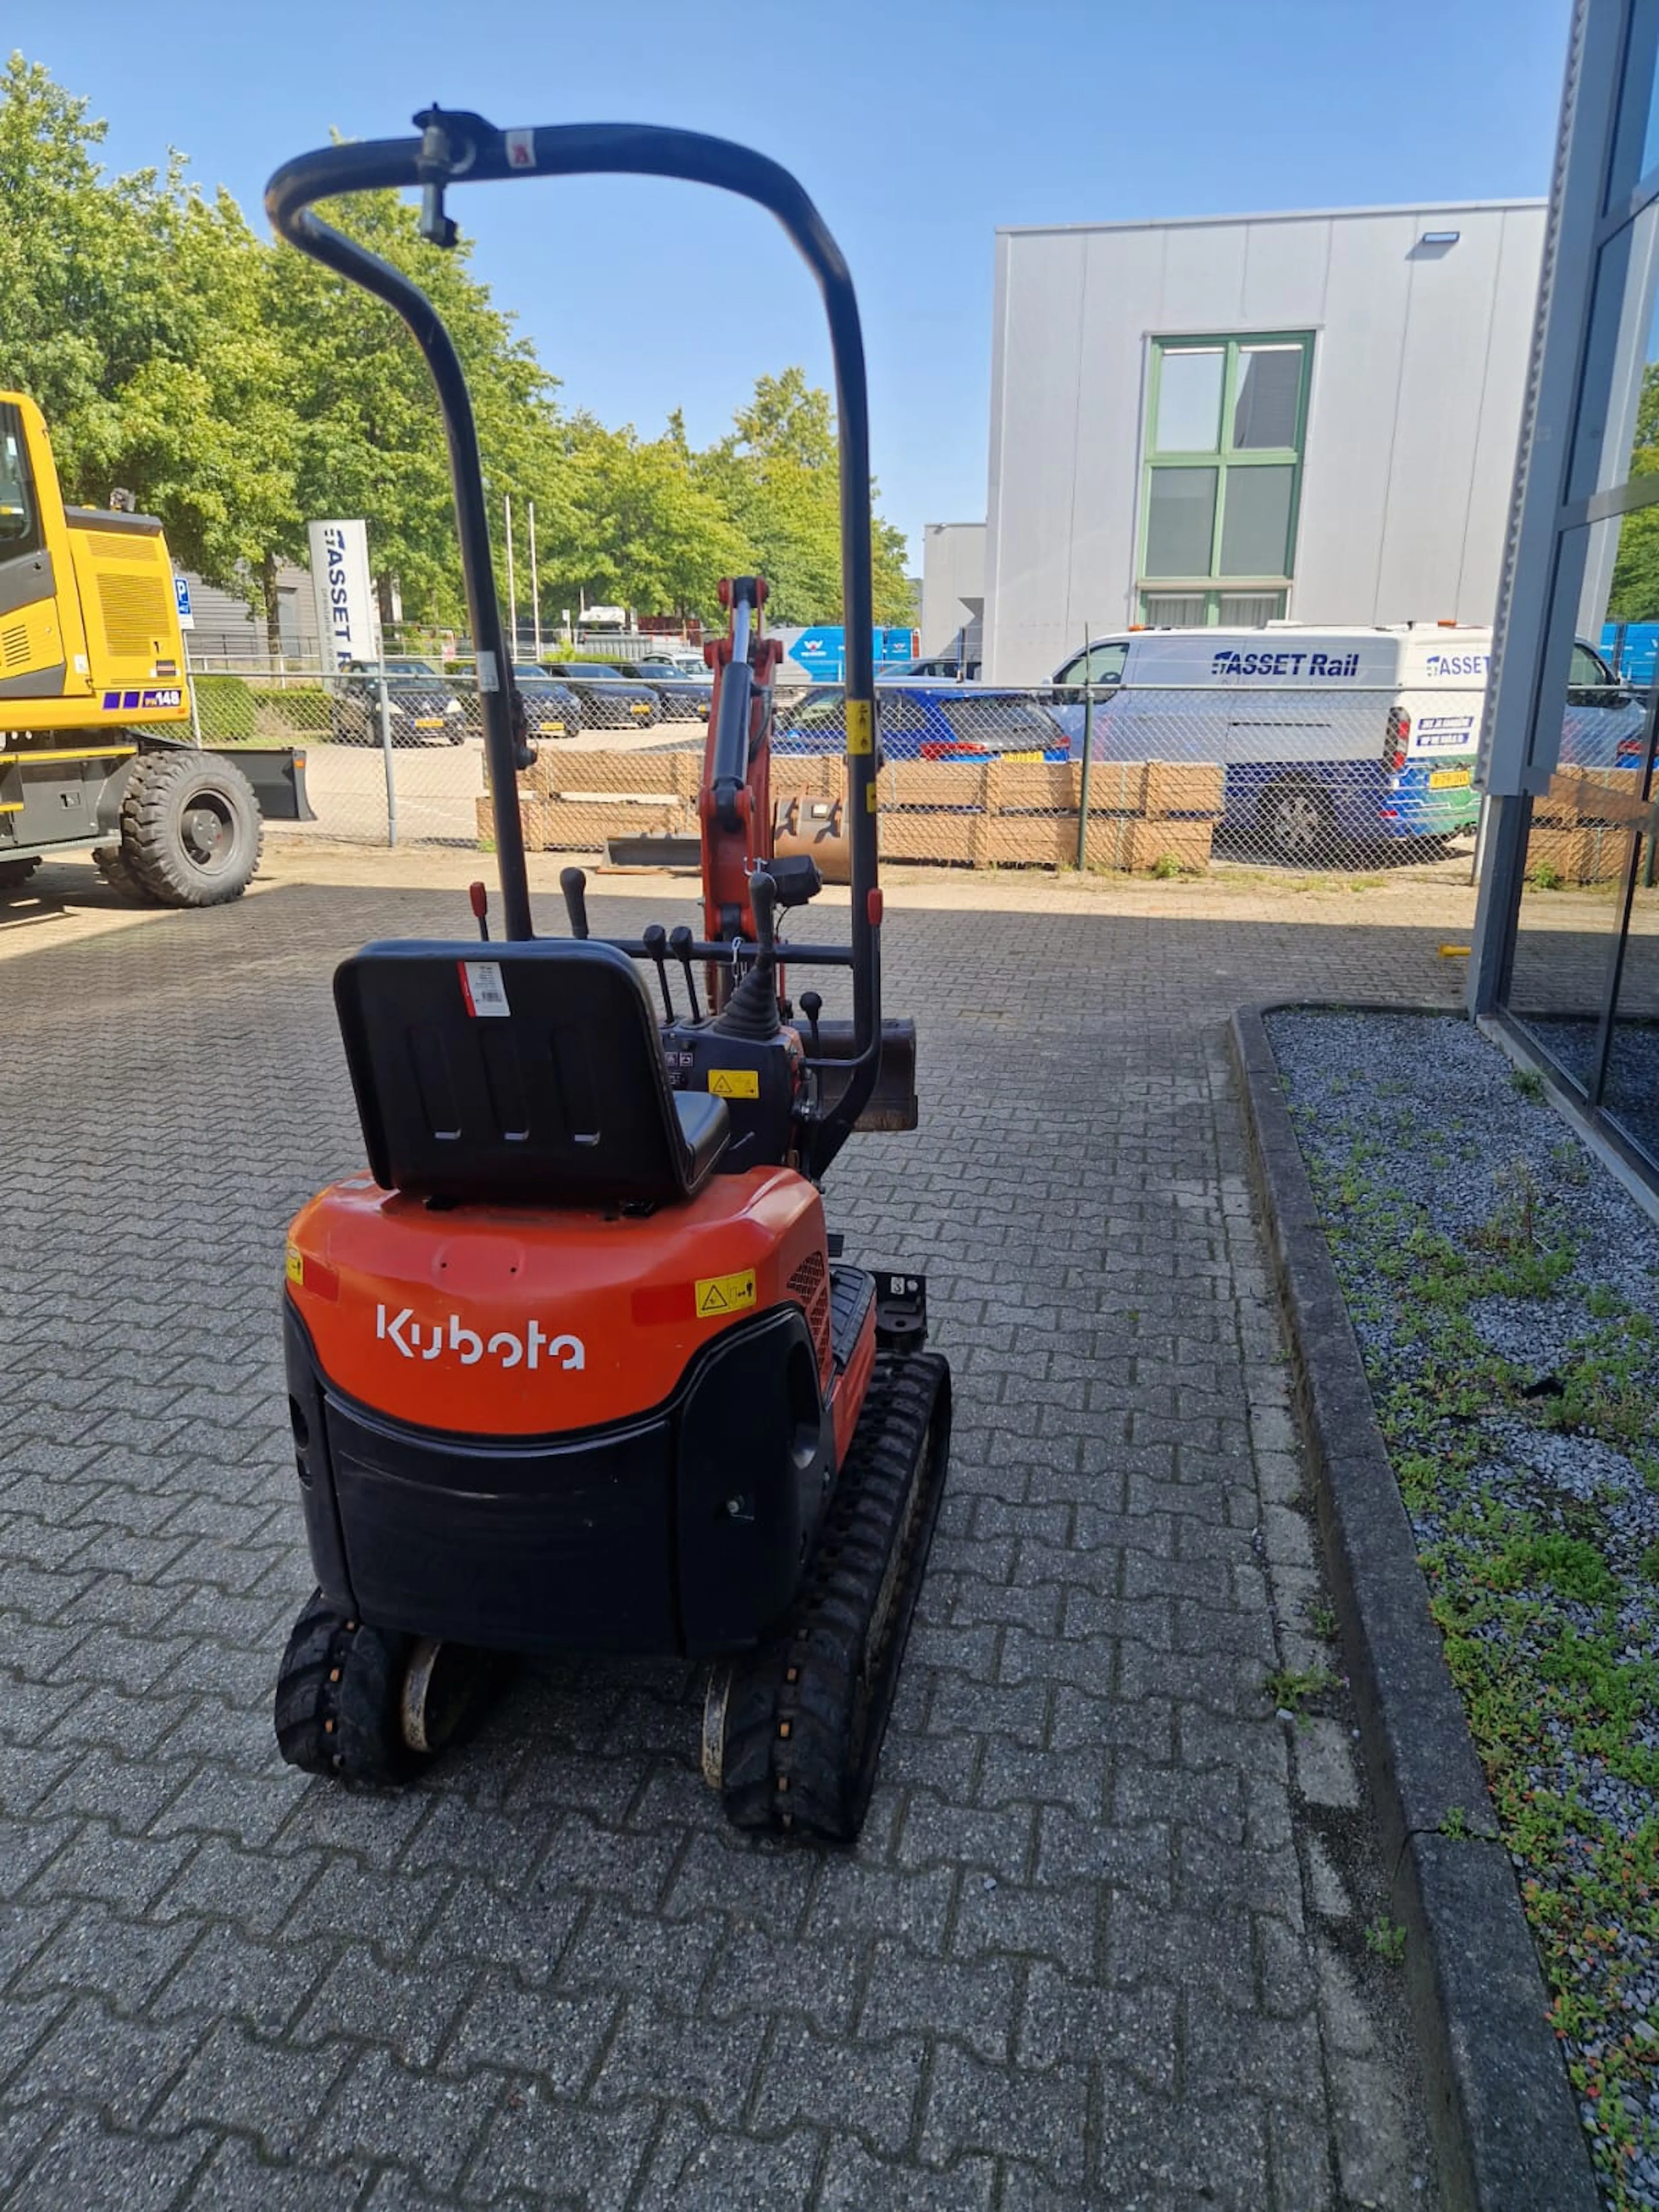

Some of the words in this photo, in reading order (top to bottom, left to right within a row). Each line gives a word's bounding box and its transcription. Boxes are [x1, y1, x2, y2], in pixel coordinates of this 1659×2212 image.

[176, 582, 186, 601] P
[327, 549, 351, 642] ASSET
[1226, 654, 1307, 675] ASSET
[1309, 654, 1360, 676] Rail
[376, 1304, 585, 1370] Kubota
